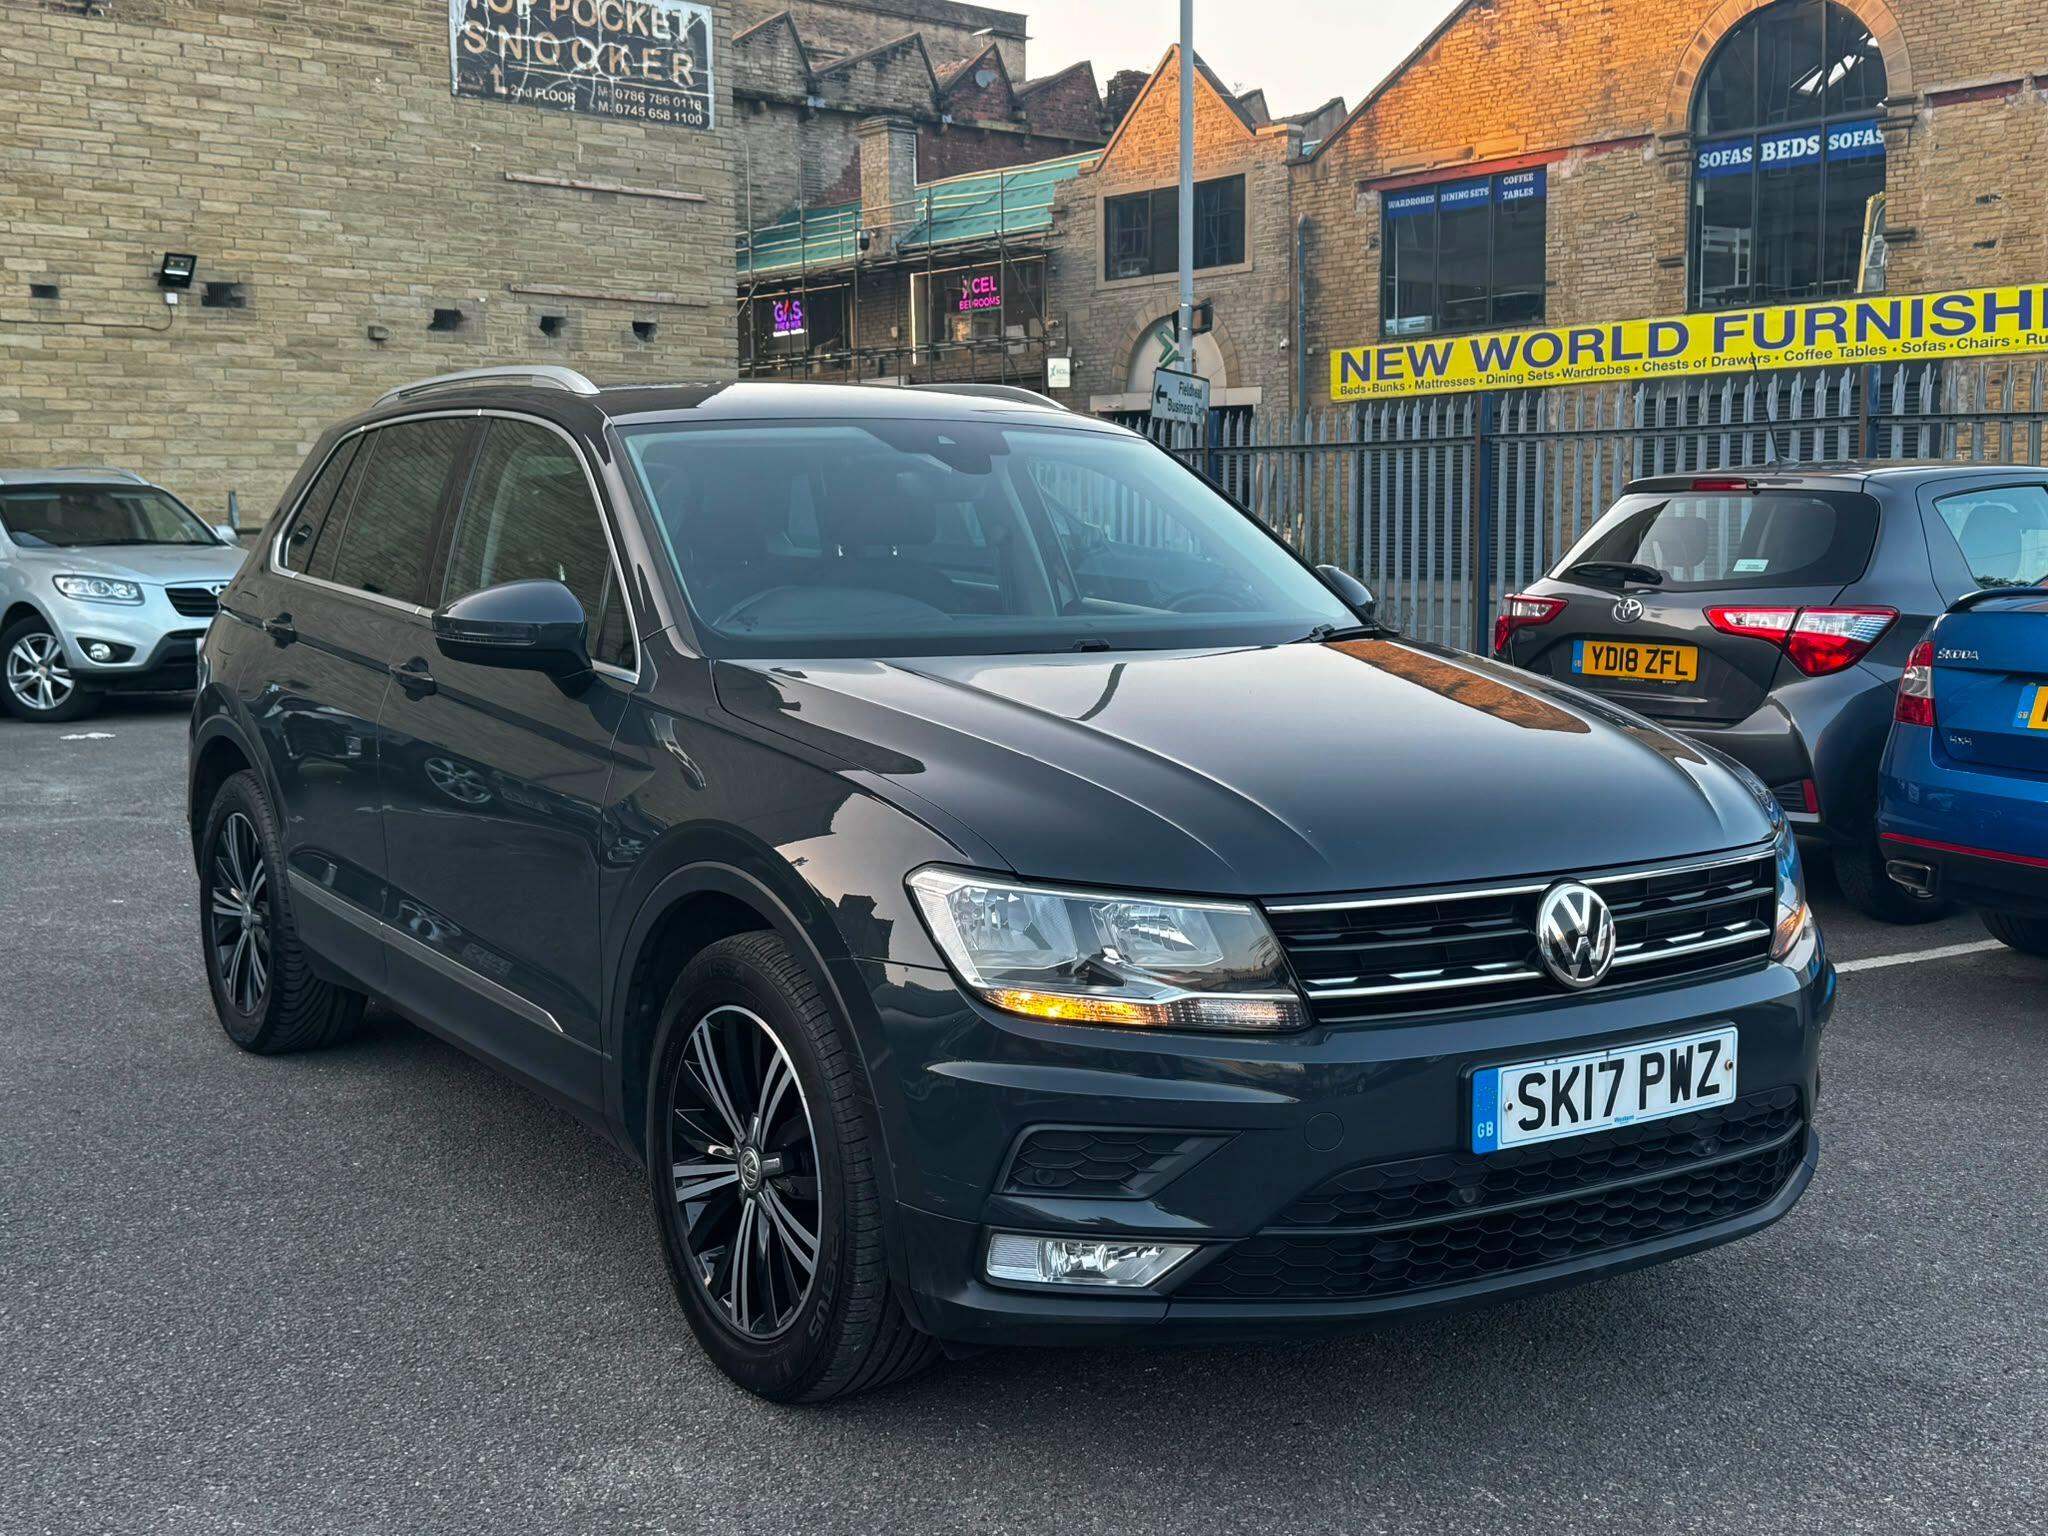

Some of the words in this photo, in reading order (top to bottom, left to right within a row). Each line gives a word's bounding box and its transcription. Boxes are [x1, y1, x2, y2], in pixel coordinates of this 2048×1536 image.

[550, 0, 692, 43] POCKET
[463, 20, 694, 85] SNOOKER
[510, 84, 532, 97] 2nd
[535, 88, 576, 104] FLOOR
[598, 101, 613, 113] M:
[615, 104, 646, 117] 0745
[648, 108, 670, 121] 658
[674, 112, 702, 125] 1100
[1760, 135, 1820, 162] BEDS
[1828, 128, 1885, 151] SOFAS
[1699, 146, 1752, 169] SOFAS
[1503, 173, 1534, 185] COFFEE
[1388, 195, 1435, 209] WARDROBES
[1441, 189, 1469, 202] DINING
[1470, 187, 1489, 198] SETS
[1503, 187, 1534, 200] TABLES
[1341, 342, 1454, 383] NEW
[1469, 321, 1690, 373] WORLD
[1341, 385, 1366, 395] Beds
[1372, 382, 1405, 393] Bunks
[1415, 377, 1475, 390] Mattresses
[1486, 372, 1524, 385] Dining
[1528, 369, 1554, 381] Sets
[1561, 364, 1630, 379] Wardrobes
[1642, 359, 1689, 373] Chests
[1693, 356, 1708, 368] of
[1711, 352, 1771, 368] Drawers
[1783, 349, 1833, 362] Coffee
[1838, 344, 1887, 358] Tables
[1901, 340, 1946, 353] Sofas
[1956, 335, 2011, 350] Chairs
[1592, 645, 1639, 672] YD18
[1645, 648, 1688, 676] ZFL
[1517, 1058, 1625, 1132] SK17
[1639, 1039, 1722, 1111] PWZ
[1476, 1121, 1494, 1139] GB
